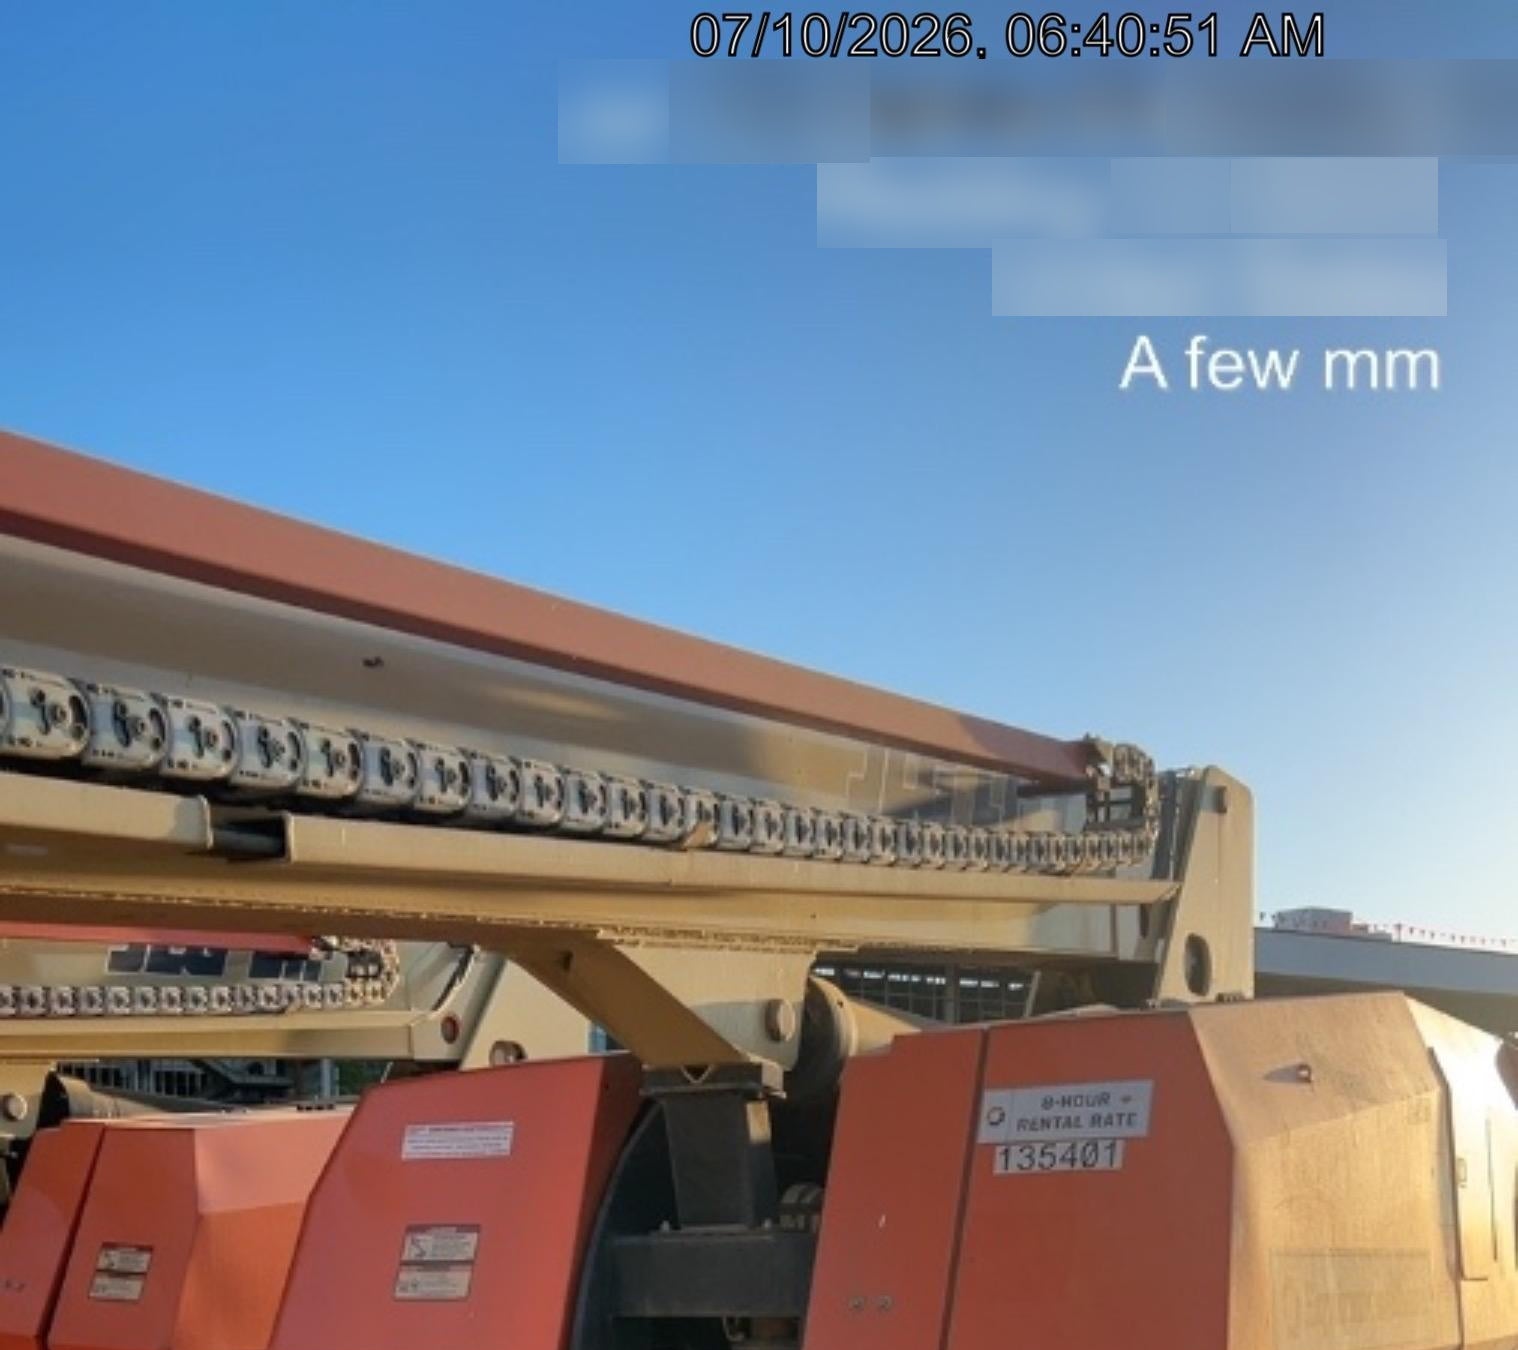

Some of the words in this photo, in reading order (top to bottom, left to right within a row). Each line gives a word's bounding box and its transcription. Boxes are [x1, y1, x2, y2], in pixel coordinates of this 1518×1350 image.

[1016, 1115, 1084, 1132] RENTAL
[1089, 1112, 1138, 1129] RATE
[999, 1139, 1118, 1171] 135401
